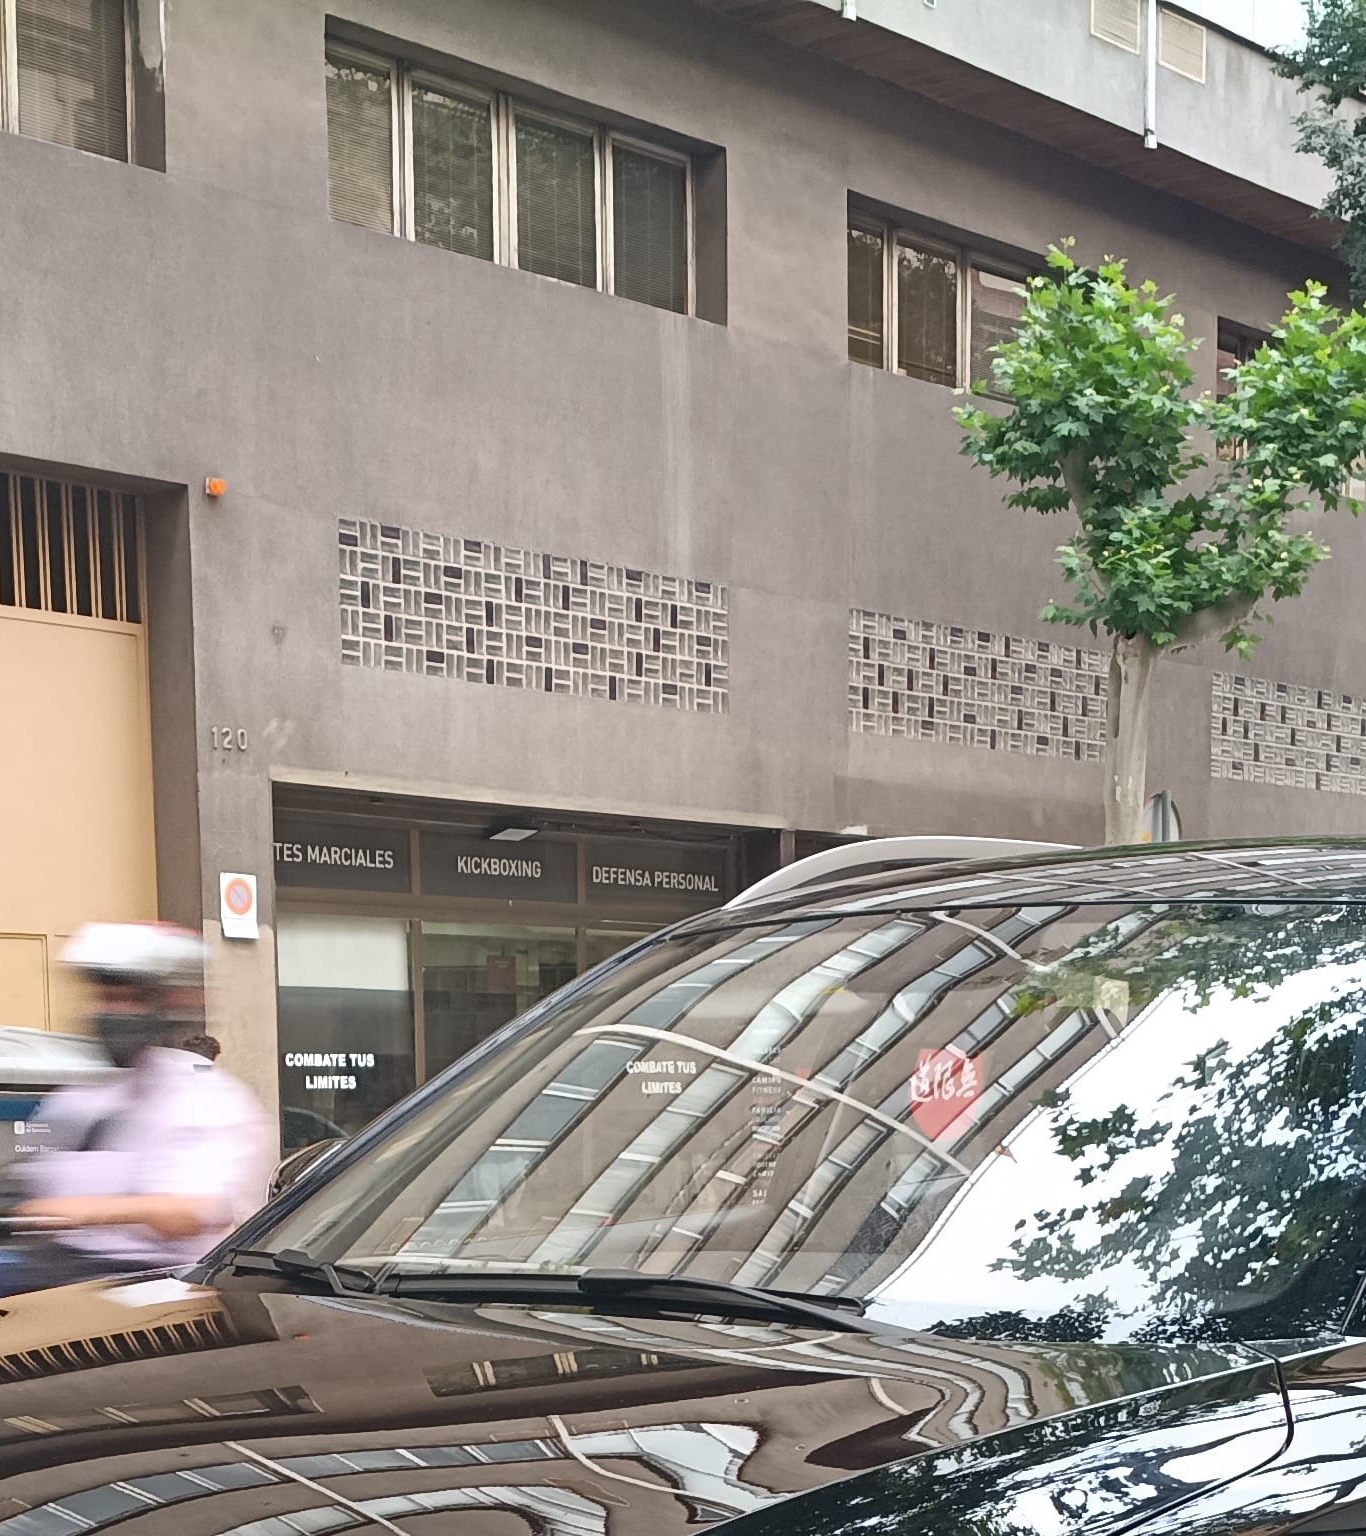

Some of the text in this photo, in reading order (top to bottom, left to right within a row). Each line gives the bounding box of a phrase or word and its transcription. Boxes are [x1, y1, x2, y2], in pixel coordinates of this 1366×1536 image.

[211, 726, 247, 751] 120
[307, 845, 394, 869] MARCIALES
[457, 855, 542, 878] KICKBOXING
[592, 866, 719, 892] DEFENSA PERSONAL
[285, 1053, 375, 1067] COMBATE TUS
[625, 1061, 696, 1074] COMBATE TUS
[305, 1075, 356, 1089] LIMITES
[641, 1081, 682, 1094] LIMITES
